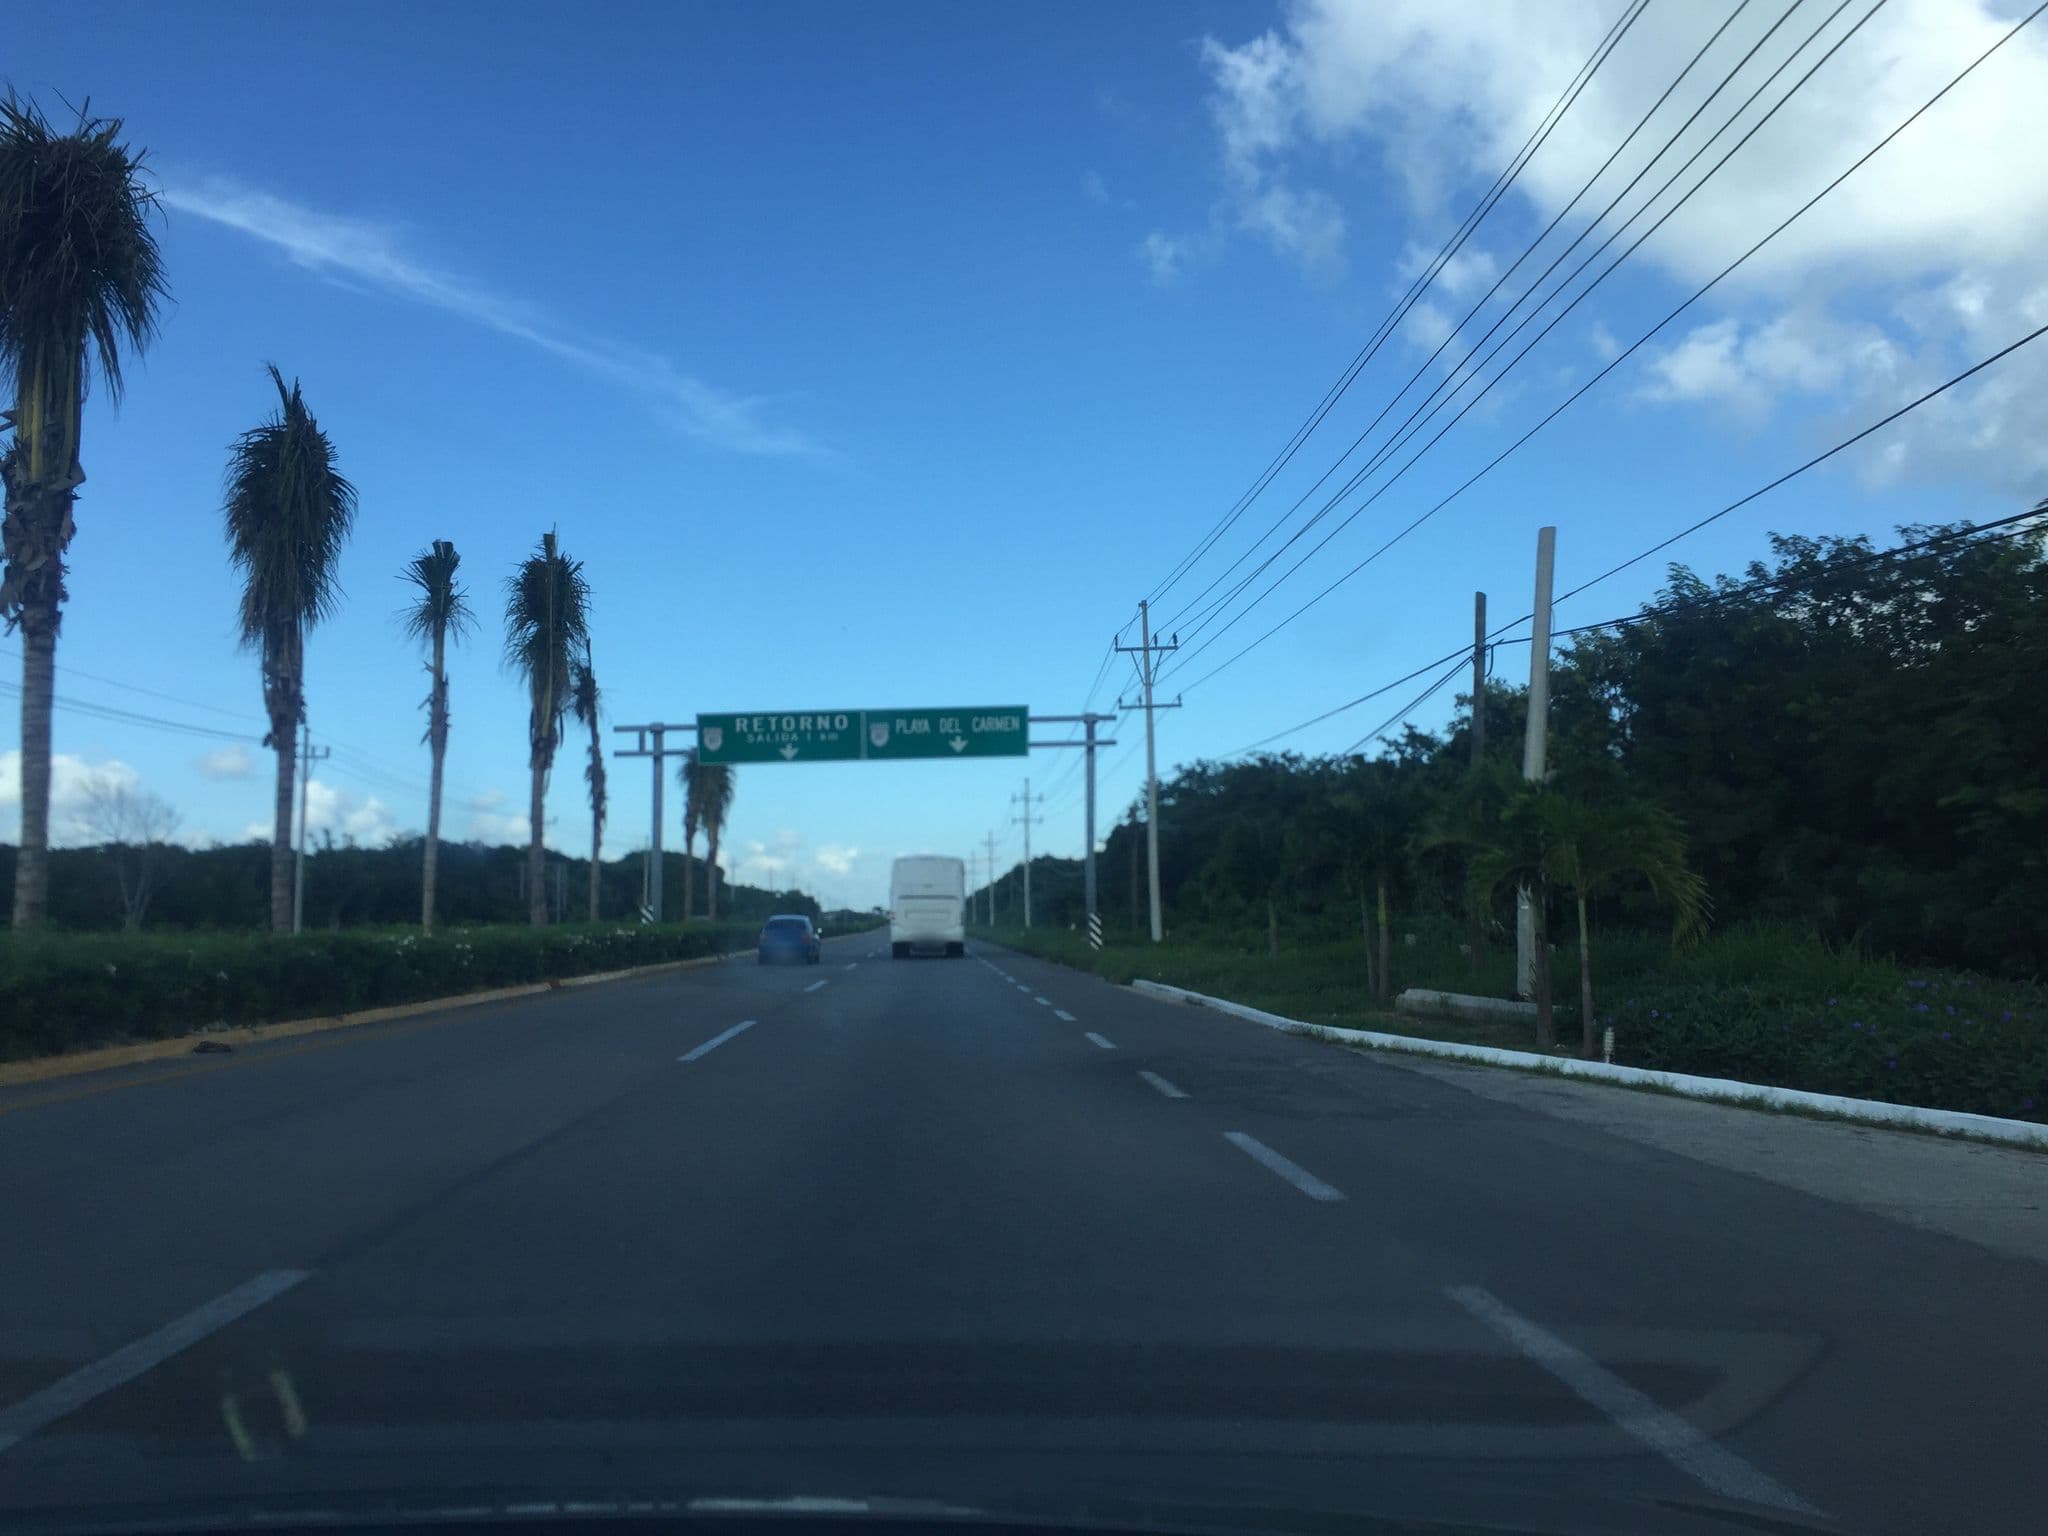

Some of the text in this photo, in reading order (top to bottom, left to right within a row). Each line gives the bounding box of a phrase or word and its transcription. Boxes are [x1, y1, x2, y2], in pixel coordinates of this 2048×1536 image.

[735, 715, 848, 732] RETORNO
[895, 715, 1021, 734] PLAYA DEL CARMEN
[746, 732, 799, 744] SALIDA
